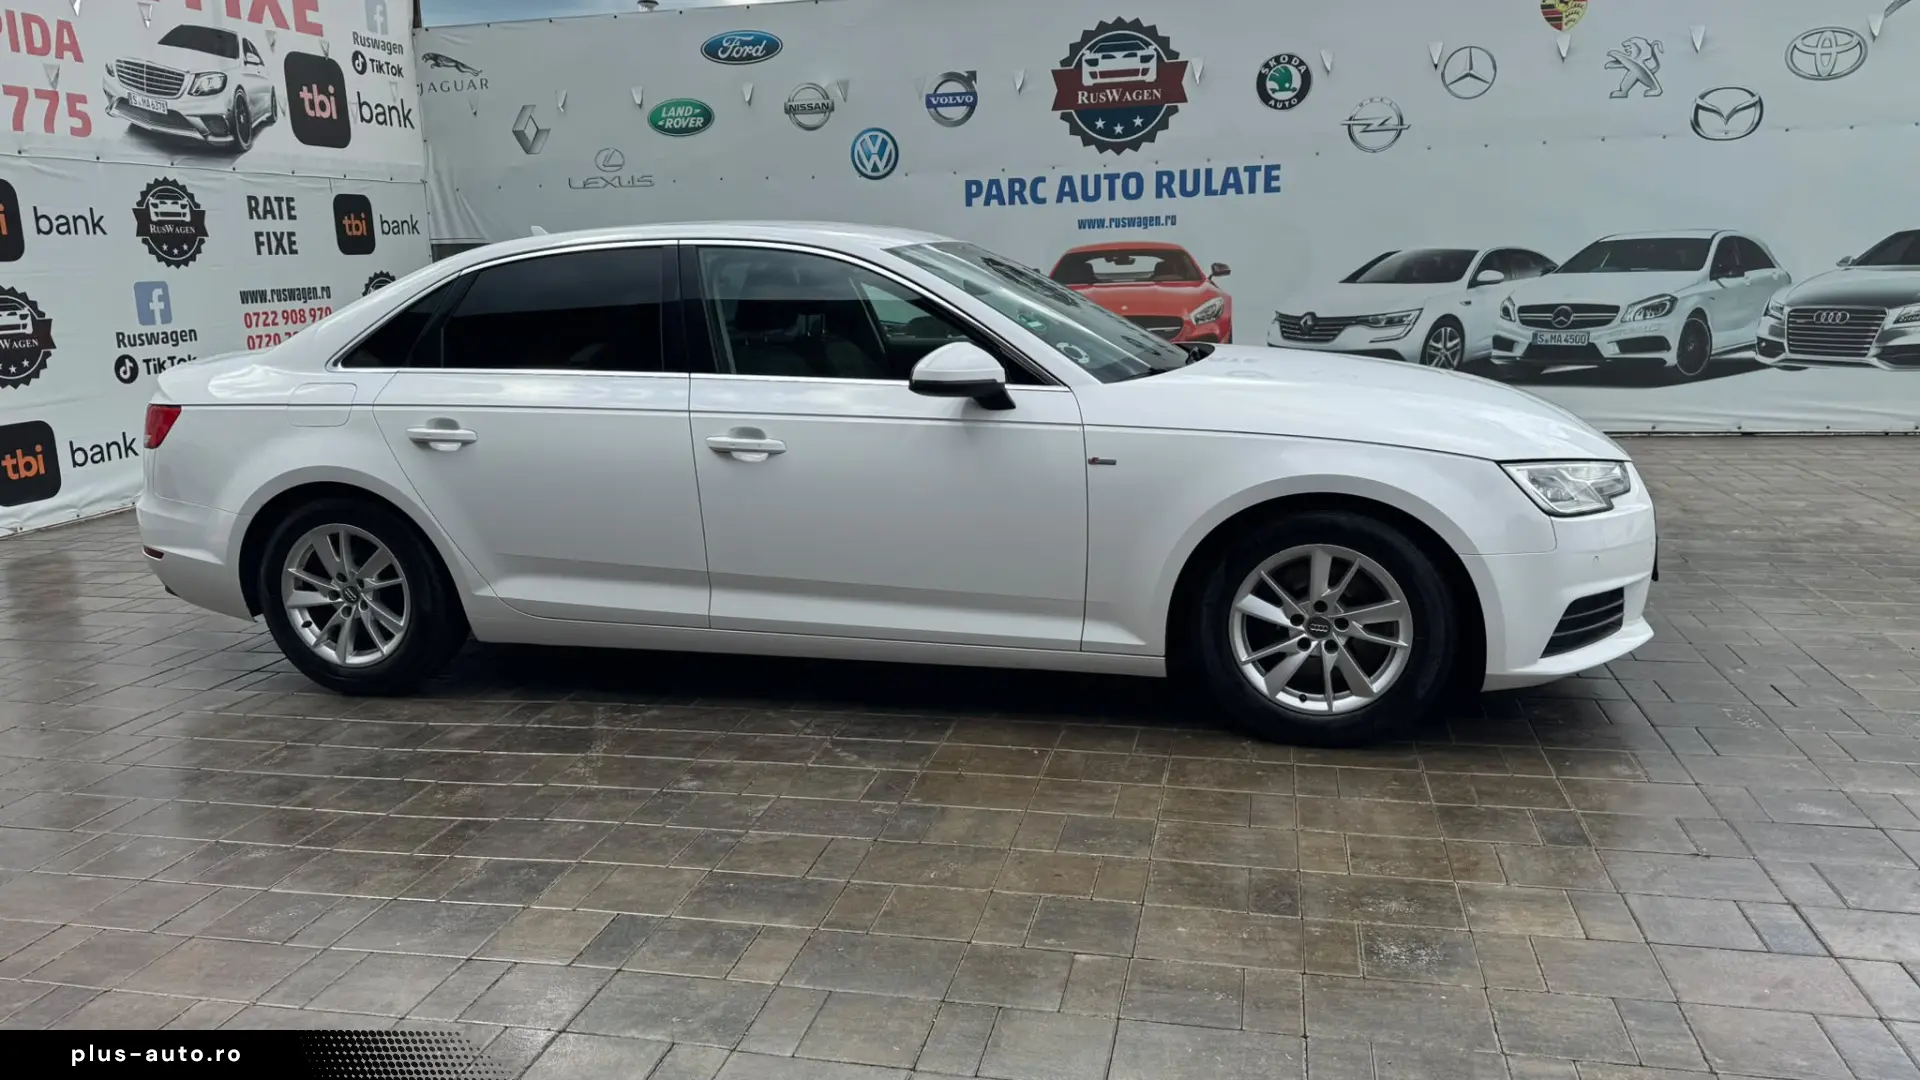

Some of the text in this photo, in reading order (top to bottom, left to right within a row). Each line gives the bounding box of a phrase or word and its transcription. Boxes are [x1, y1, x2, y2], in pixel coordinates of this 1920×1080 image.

[0, 9, 84, 63] IDA
[352, 31, 404, 56] Ruswagen
[718, 35, 767, 59] Ford
[369, 58, 404, 78] TikTok
[418, 78, 490, 96] JAGUAR
[299, 84, 415, 129] tbi bank
[788, 102, 830, 112] NISSAN
[929, 95, 974, 105] VOLVO
[1268, 97, 1298, 109] AUTO
[2, 84, 92, 138] 775
[661, 106, 692, 118] LAND
[664, 117, 704, 129] ROVER
[568, 175, 654, 190] LEXUS
[964, 164, 1281, 207] PARC AUTO RULATE
[247, 195, 297, 220] RATE
[33, 206, 108, 236] bank
[342, 213, 421, 236] tbi bank
[1078, 214, 1176, 230] www.ruswagen.ro
[254, 231, 299, 255] FIXE
[239, 286, 331, 304] www.ruswagen.ro
[244, 311, 279, 329] 0722
[282, 308, 306, 325] 908
[116, 328, 198, 348] Ruswagen
[247, 333, 282, 350] 0720
[2, 431, 139, 480] tbi bank
